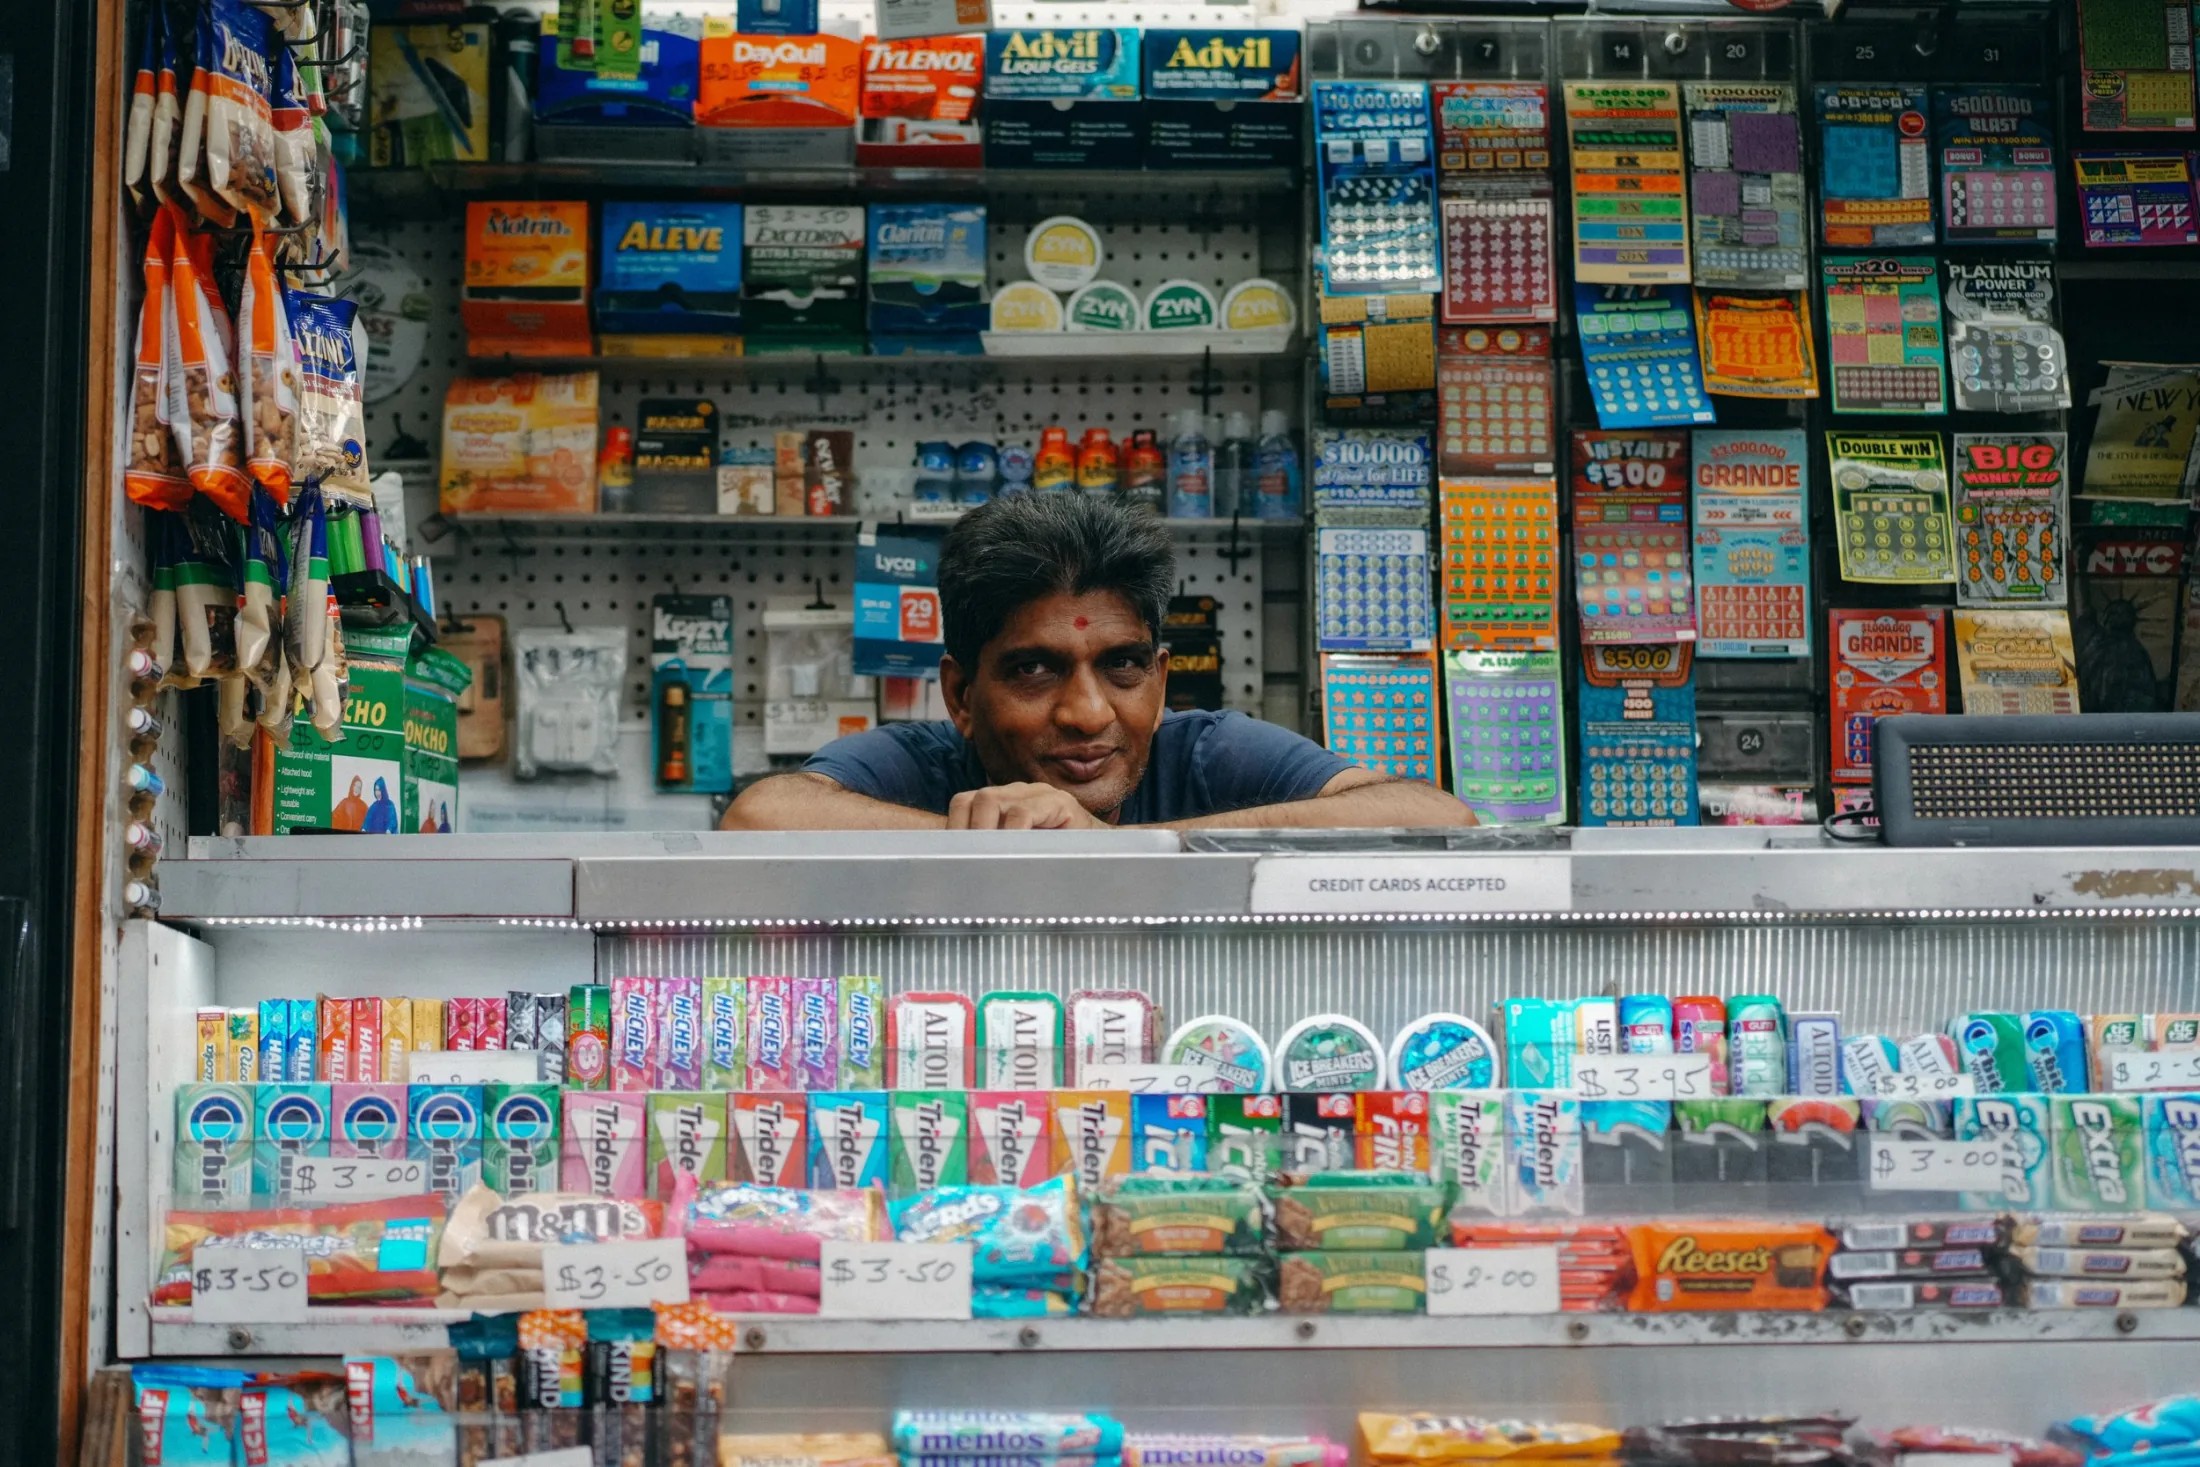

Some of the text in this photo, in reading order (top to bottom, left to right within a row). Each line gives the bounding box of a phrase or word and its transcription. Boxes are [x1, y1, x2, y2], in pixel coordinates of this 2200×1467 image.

[733, 41, 827, 68] DayQuil
[865, 44, 977, 72] TYLENOL
[1001, 30, 1101, 59] Advil
[1166, 37, 1271, 69] Advil
[1483, 44, 1494, 57] 7
[1613, 44, 1630, 58] 14
[1727, 44, 1747, 58] 20
[1855, 46, 1875, 60] 25
[1983, 48, 2000, 62] 31
[1001, 60, 1098, 75] LIQUI-GELS
[1444, 112, 1544, 128] FORTUNE
[1969, 117, 2018, 133] BLAST
[618, 220, 723, 251] ALEVE
[877, 224, 945, 244] Claritin
[1040, 235, 1087, 253] ZYN
[1854, 259, 1899, 274] X20
[1949, 265, 2051, 279] PLATINUM
[1975, 279, 2027, 290] POWER
[1080, 298, 1128, 318] ZYN
[1155, 298, 1201, 318] ZYN
[1235, 299, 1278, 318] ZYN
[2116, 388, 2180, 411] NEW
[1324, 440, 1422, 464] $10,000
[1581, 440, 1682, 460] INSTANT
[1840, 441, 1932, 456] DOUBLE WIN
[1968, 445, 2056, 470] BIG
[1392, 468, 1427, 482] LIFE
[1585, 462, 1667, 489] $500
[1698, 463, 1802, 487] GRANDE
[875, 553, 917, 573] Lyca
[2087, 545, 2176, 574] NYC
[1603, 647, 1672, 669] $500
[1848, 636, 1925, 653] GRANDE
[405, 720, 448, 753] ONCHO
[1741, 733, 1761, 750] 24
[280, 786, 306, 797] Lightweight
[1309, 877, 1507, 892] CREDIT CARDS ACCEPTED
[625, 992, 649, 1069] HI-CHEW
[670, 993, 694, 1070] HI-CHEW
[713, 993, 736, 1070] HI-CHEW
[761, 993, 784, 1070] HI-CHEW
[804, 993, 828, 1070] HI-CHEW
[850, 992, 873, 1069] HI-CHEW
[1748, 1020, 1775, 1031] GUM
[2105, 1032, 2132, 1044] tac
[2110, 1022, 2130, 1034] tic
[2167, 1031, 2196, 1044] tac
[2173, 1021, 2195, 1034] tic
[239, 1046, 254, 1083] Rico
[269, 1038, 283, 1083] HALL
[298, 1036, 312, 1083] HALL
[1290, 1050, 1375, 1082] ICE BREAKERS
[1421, 1037, 1485, 1081] BREAKERS
[1315, 1072, 1353, 1089] MINTS
[678, 1103, 704, 1173] Tride
[756, 1101, 784, 1185] Triden
[837, 1101, 864, 1188] Triden
[918, 1101, 943, 1191] Triden
[1000, 1100, 1024, 1189] Triden
[1080, 1101, 1106, 1192] Triden
[1372, 1113, 1400, 1171] FIR
[1459, 1101, 1482, 1192] Trident
[1535, 1102, 1559, 1191] Trident
[1874, 1148, 1998, 1180] $3-00
[2071, 1101, 2128, 1204] Extra
[294, 1164, 420, 1195] $3-00
[1657, 1234, 1774, 1275] Reese's
[193, 1264, 299, 1296] $3-50
[555, 1256, 673, 1300] $3-50
[828, 1258, 956, 1286] $3-50
[1430, 1264, 1538, 1295] $2-00
[609, 1334, 635, 1402] KIND
[348, 1362, 373, 1425] CLIF
[142, 1391, 164, 1448] CLIF
[243, 1393, 264, 1450] CLIF
[920, 1431, 1045, 1451] mentos
[1142, 1446, 1265, 1466] mentos
